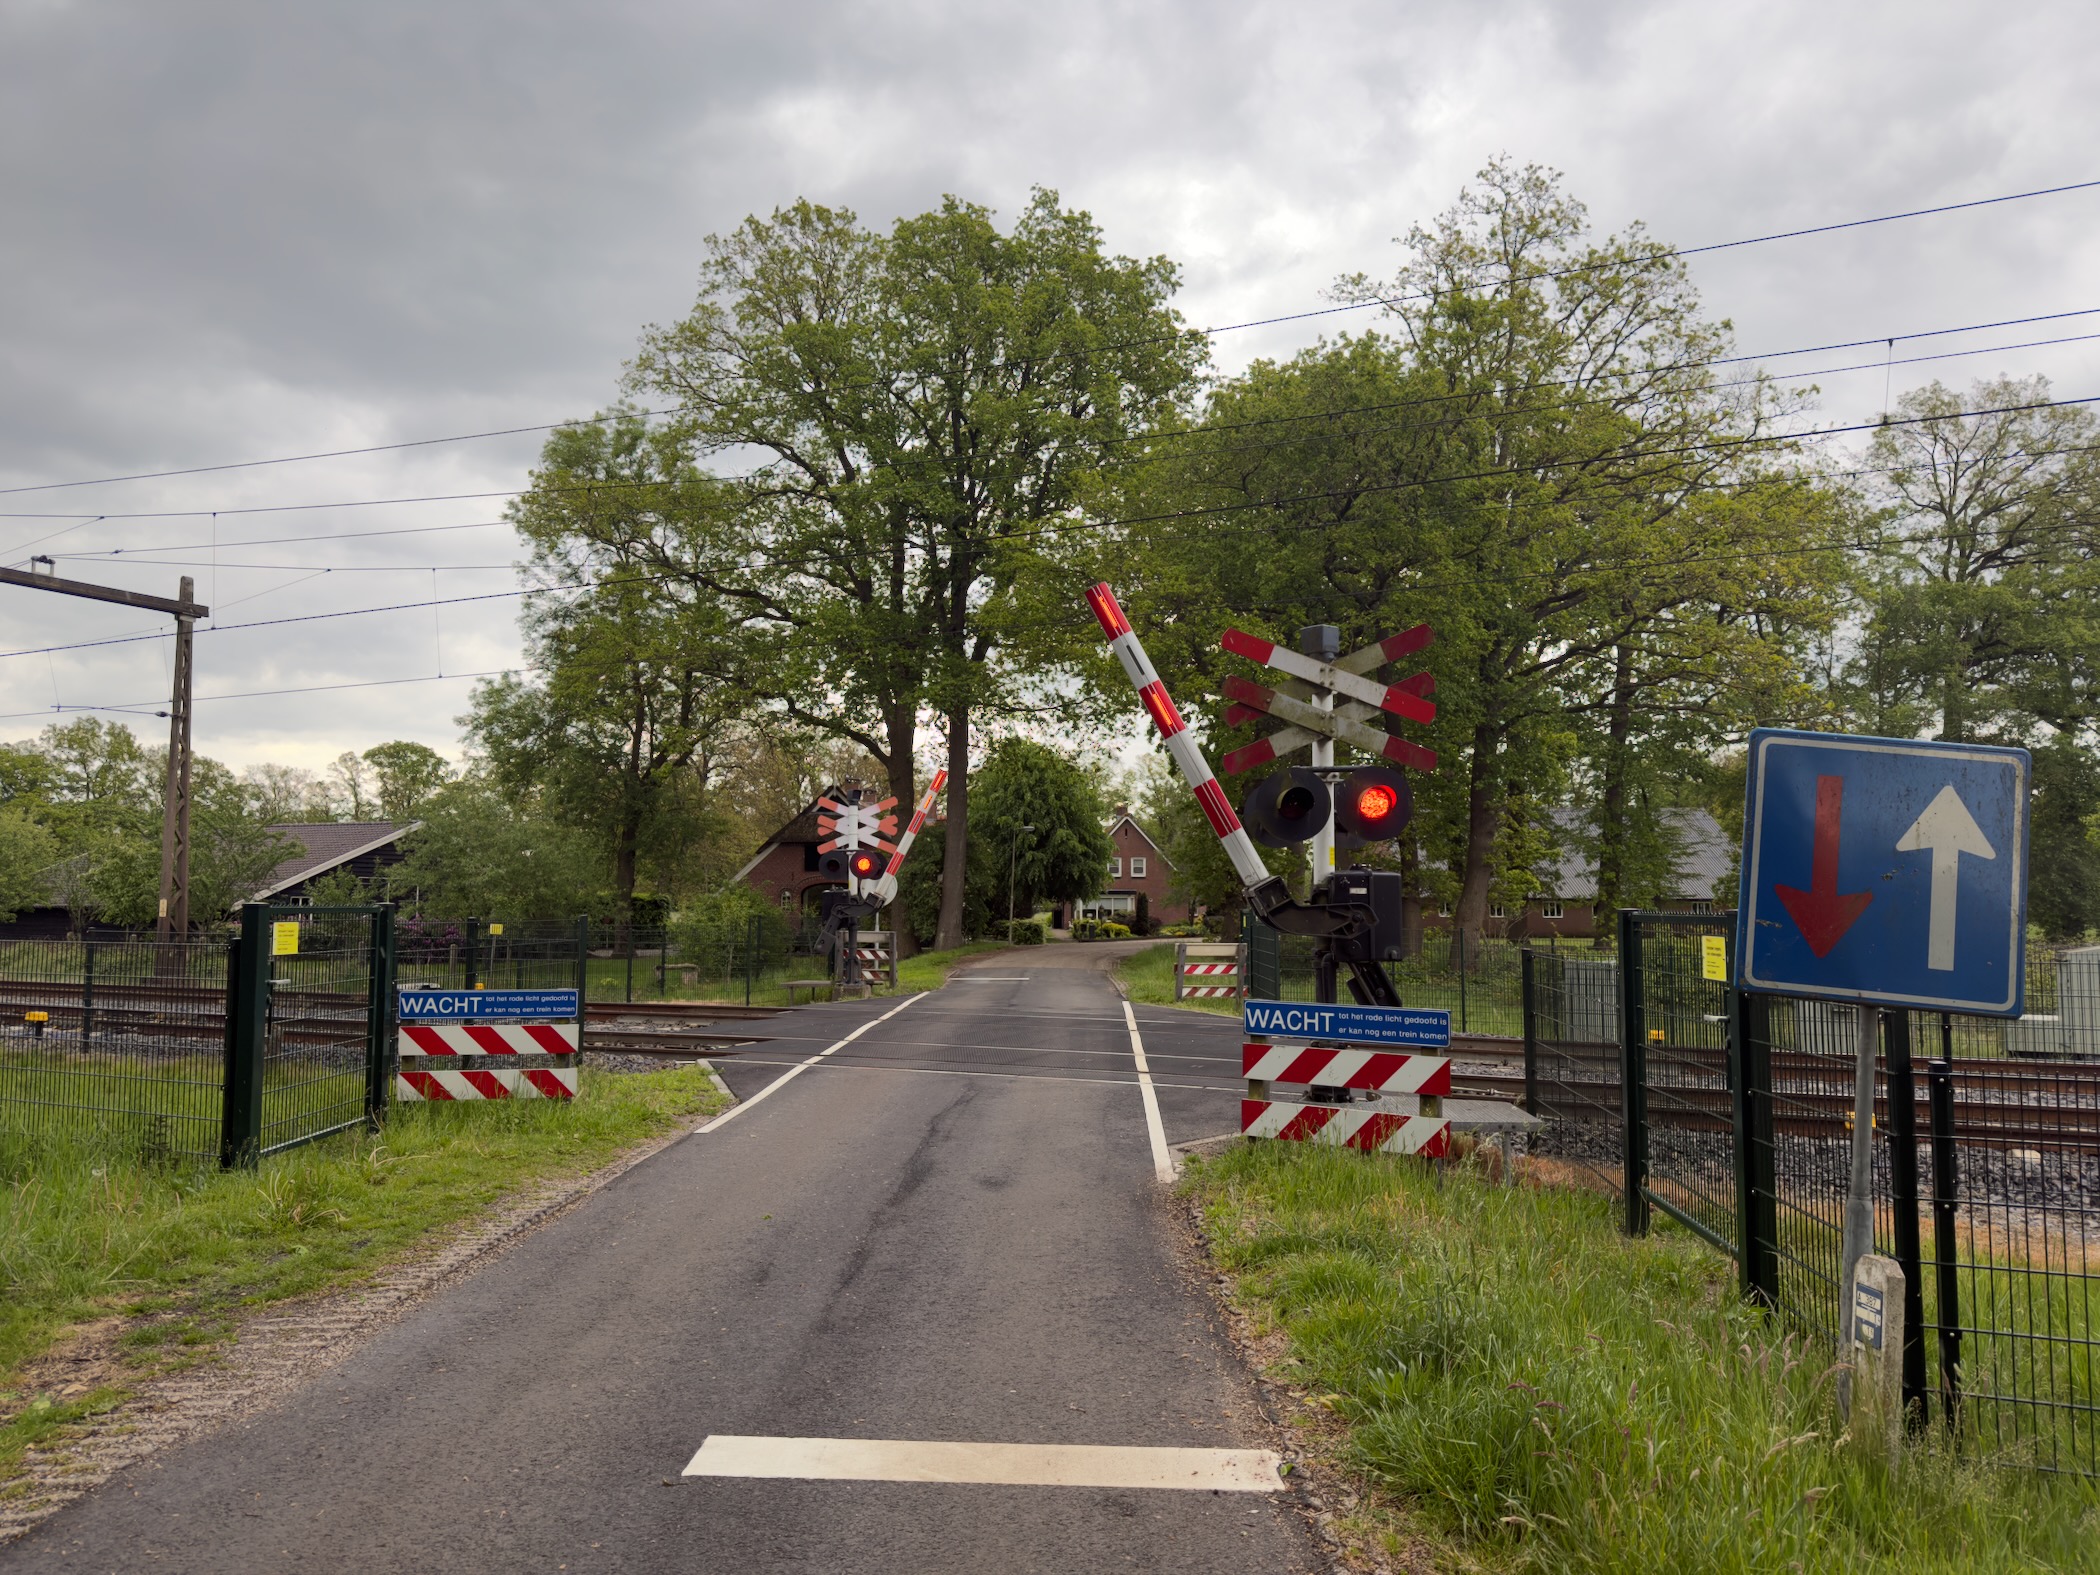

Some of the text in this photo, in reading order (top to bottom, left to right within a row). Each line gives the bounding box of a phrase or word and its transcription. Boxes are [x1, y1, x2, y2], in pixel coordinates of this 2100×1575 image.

[401, 997, 482, 1013] WACHT
[1247, 1008, 1334, 1032] WACHT
[1404, 1016, 1437, 1025] gedoofd
[1365, 1029, 1379, 1037] nog
[1419, 1032, 1447, 1040] komen
